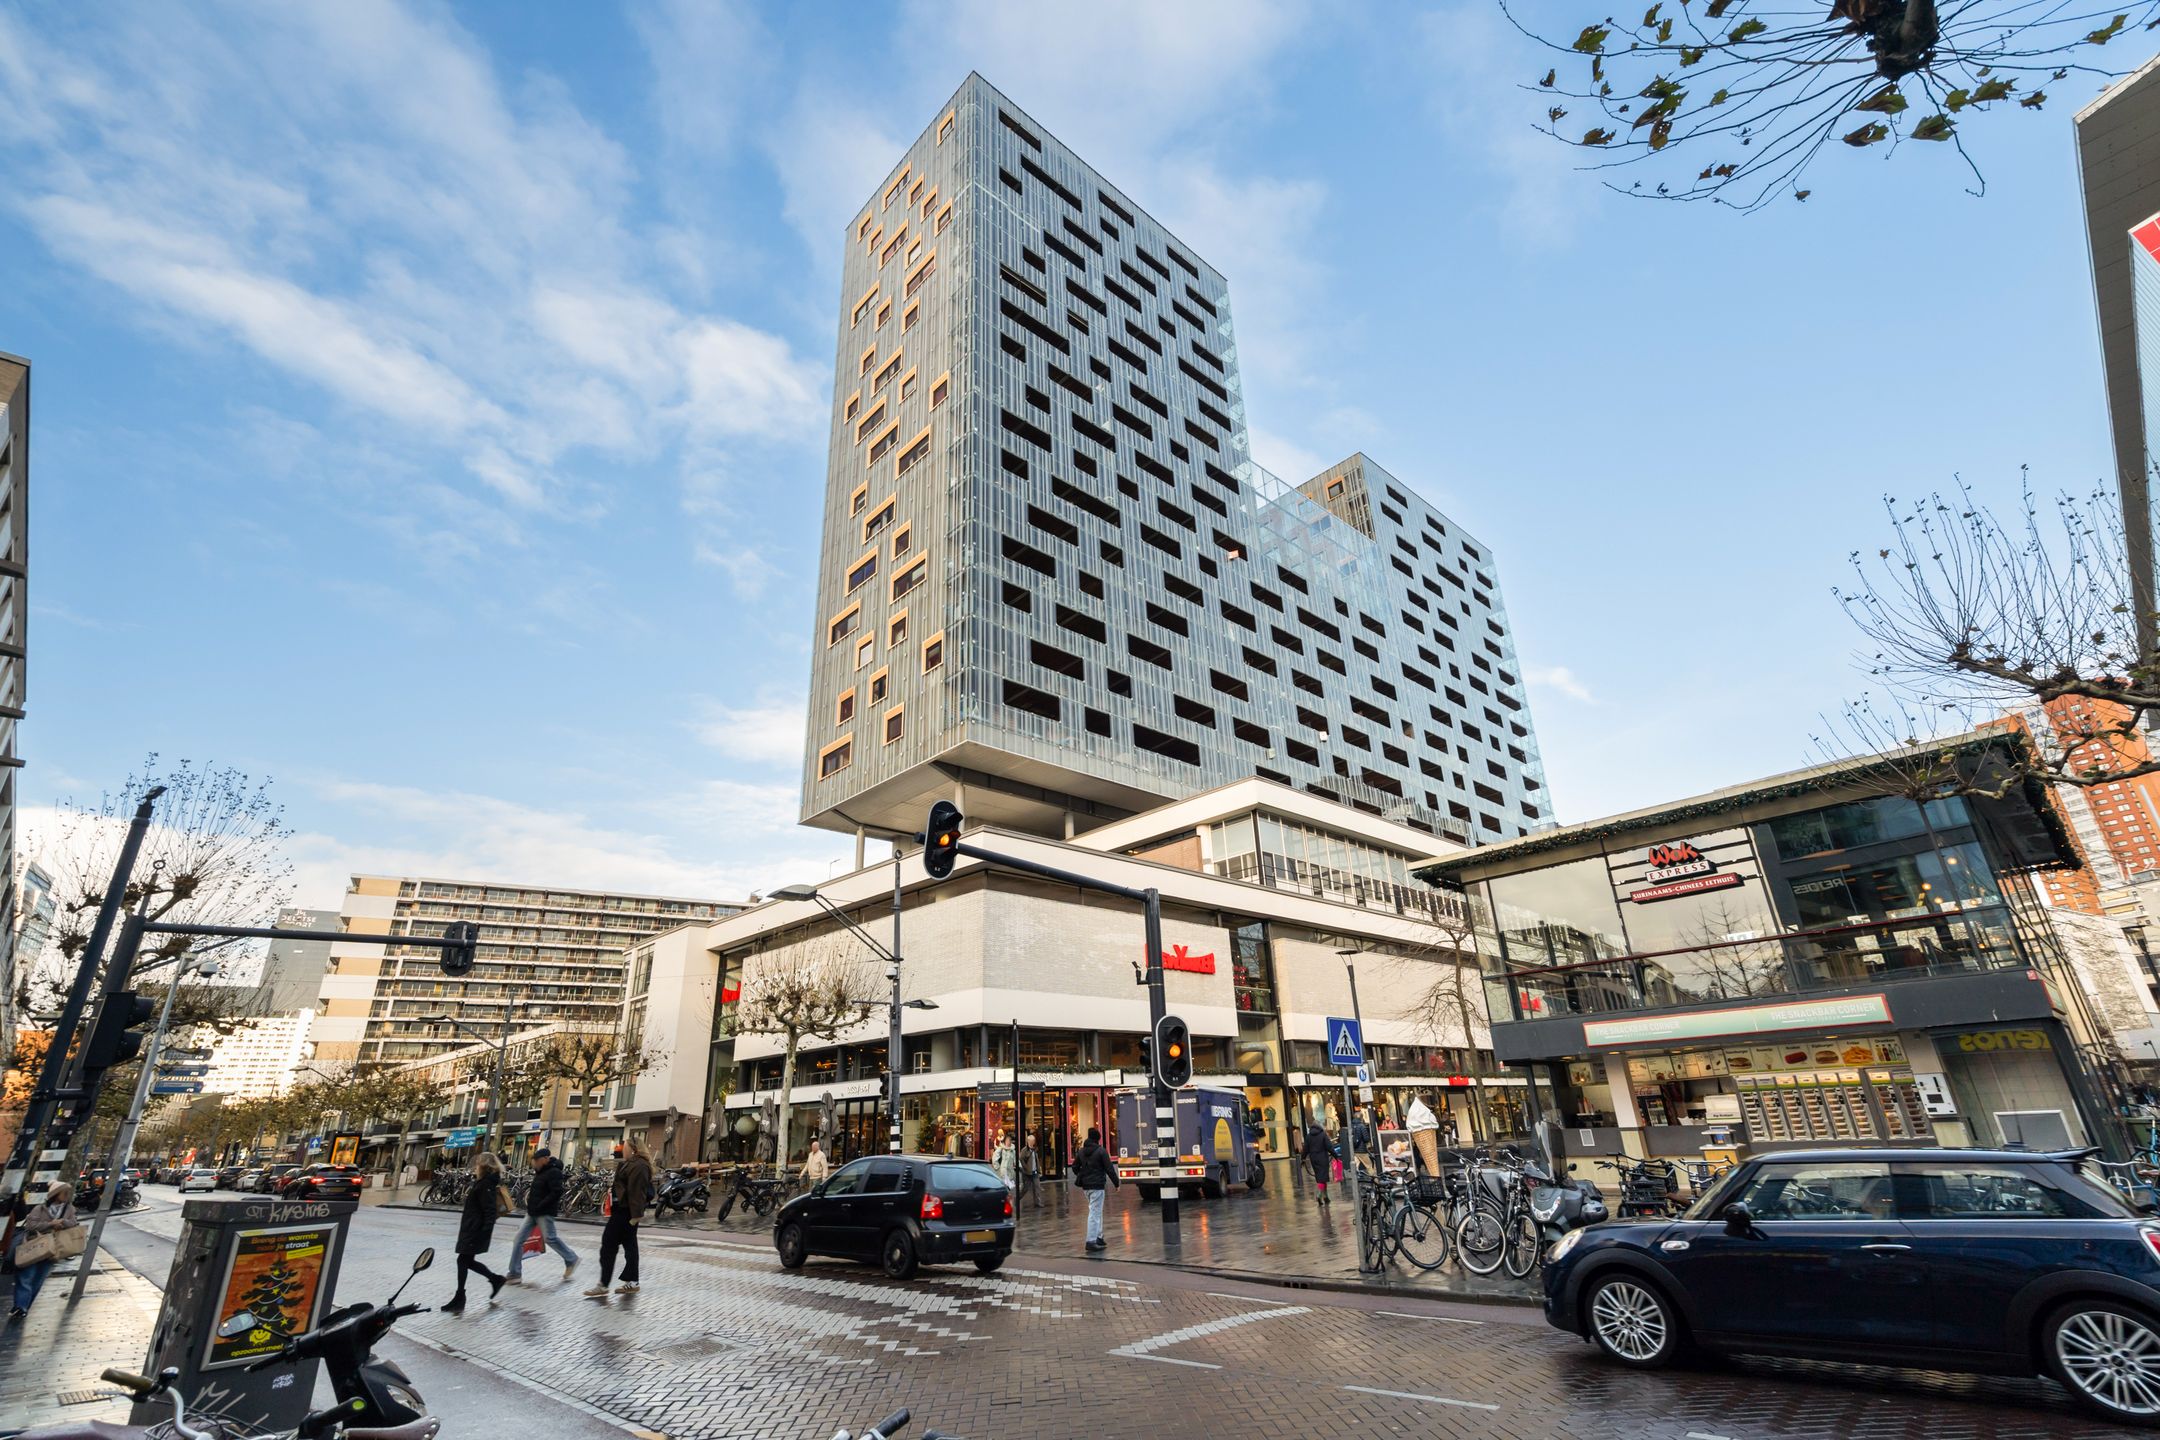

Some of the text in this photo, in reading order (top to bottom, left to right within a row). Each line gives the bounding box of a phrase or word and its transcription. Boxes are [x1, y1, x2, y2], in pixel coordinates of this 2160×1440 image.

[1649, 841, 1699, 867] Wok
[1649, 863, 1707, 880] EXPRESS
[1632, 876, 1735, 899] SURINAAMS-CHINEES EETHUIS
[1788, 1006, 1838, 1019] SNACKBAR
[1839, 1002, 1878, 1014] CORNER
[285, 1241, 310, 1249] straat
[288, 1233, 319, 1241] warmte
